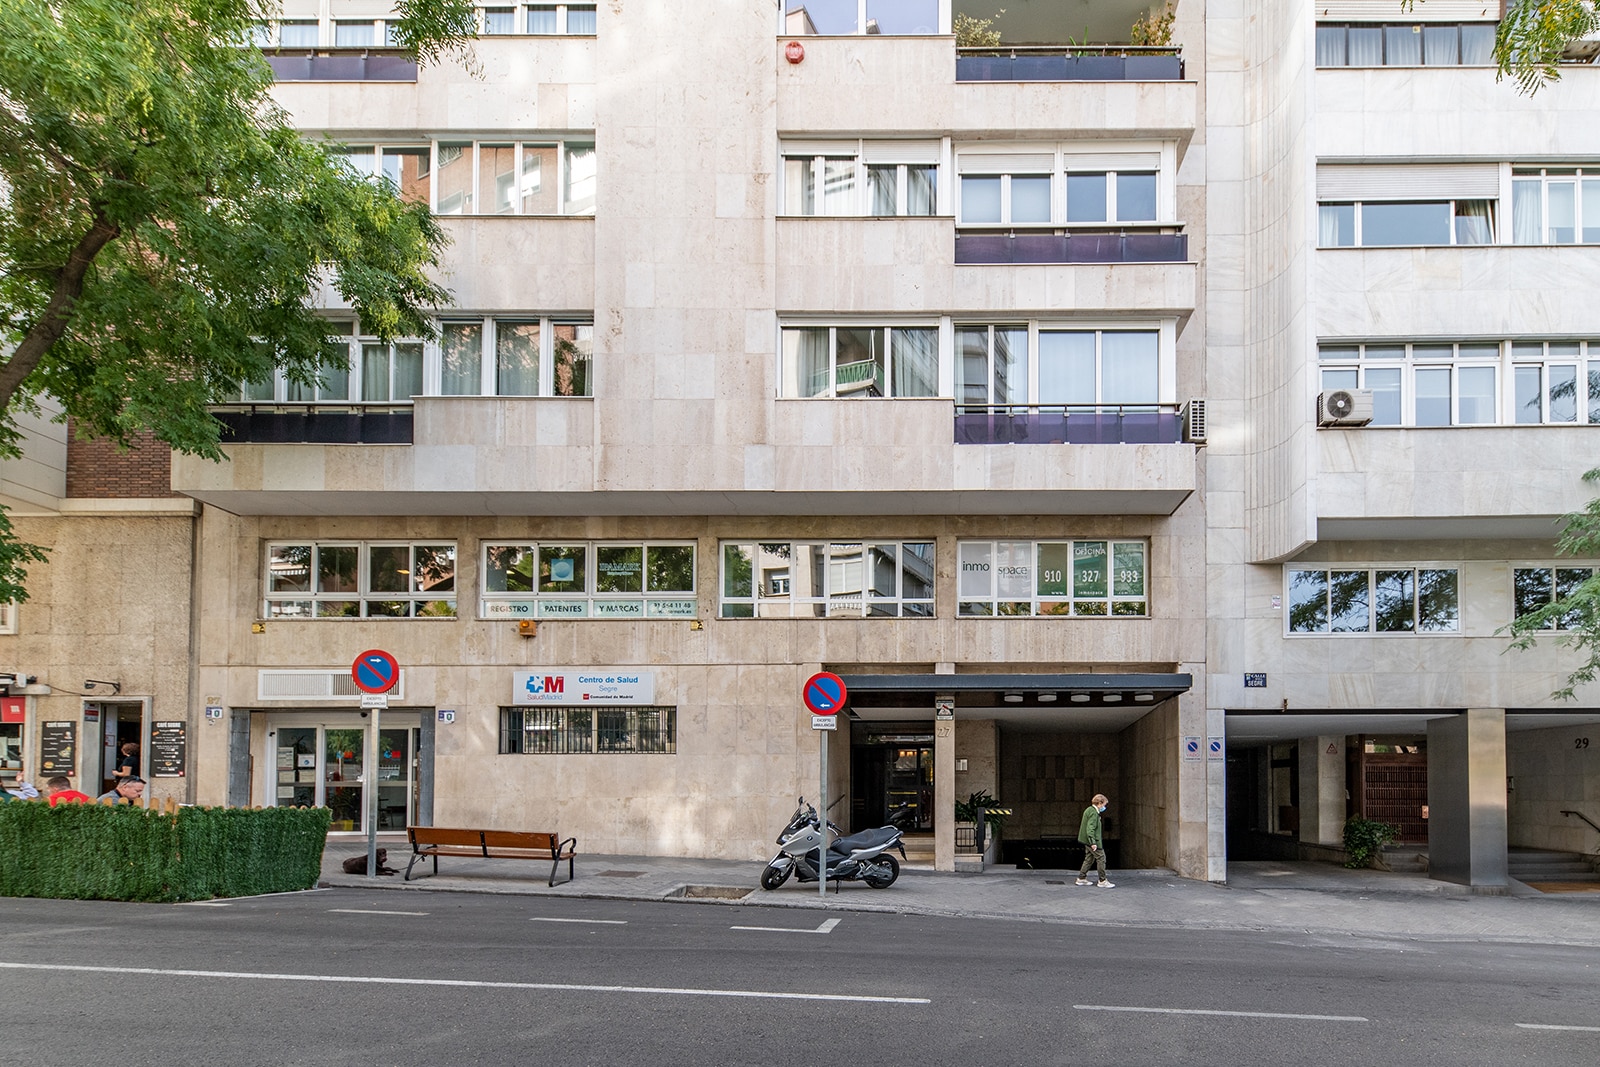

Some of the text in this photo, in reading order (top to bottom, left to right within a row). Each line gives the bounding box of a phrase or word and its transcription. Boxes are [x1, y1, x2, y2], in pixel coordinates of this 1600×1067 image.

[962, 561, 990, 571] inmo
[998, 566, 1028, 579] space
[1044, 570, 1138, 582] 910 327 933
[490, 605, 639, 613] REGISTRO PATENTES Y MARCAS
[598, 684, 618, 693] Segre
[1575, 737, 1589, 749] 29
